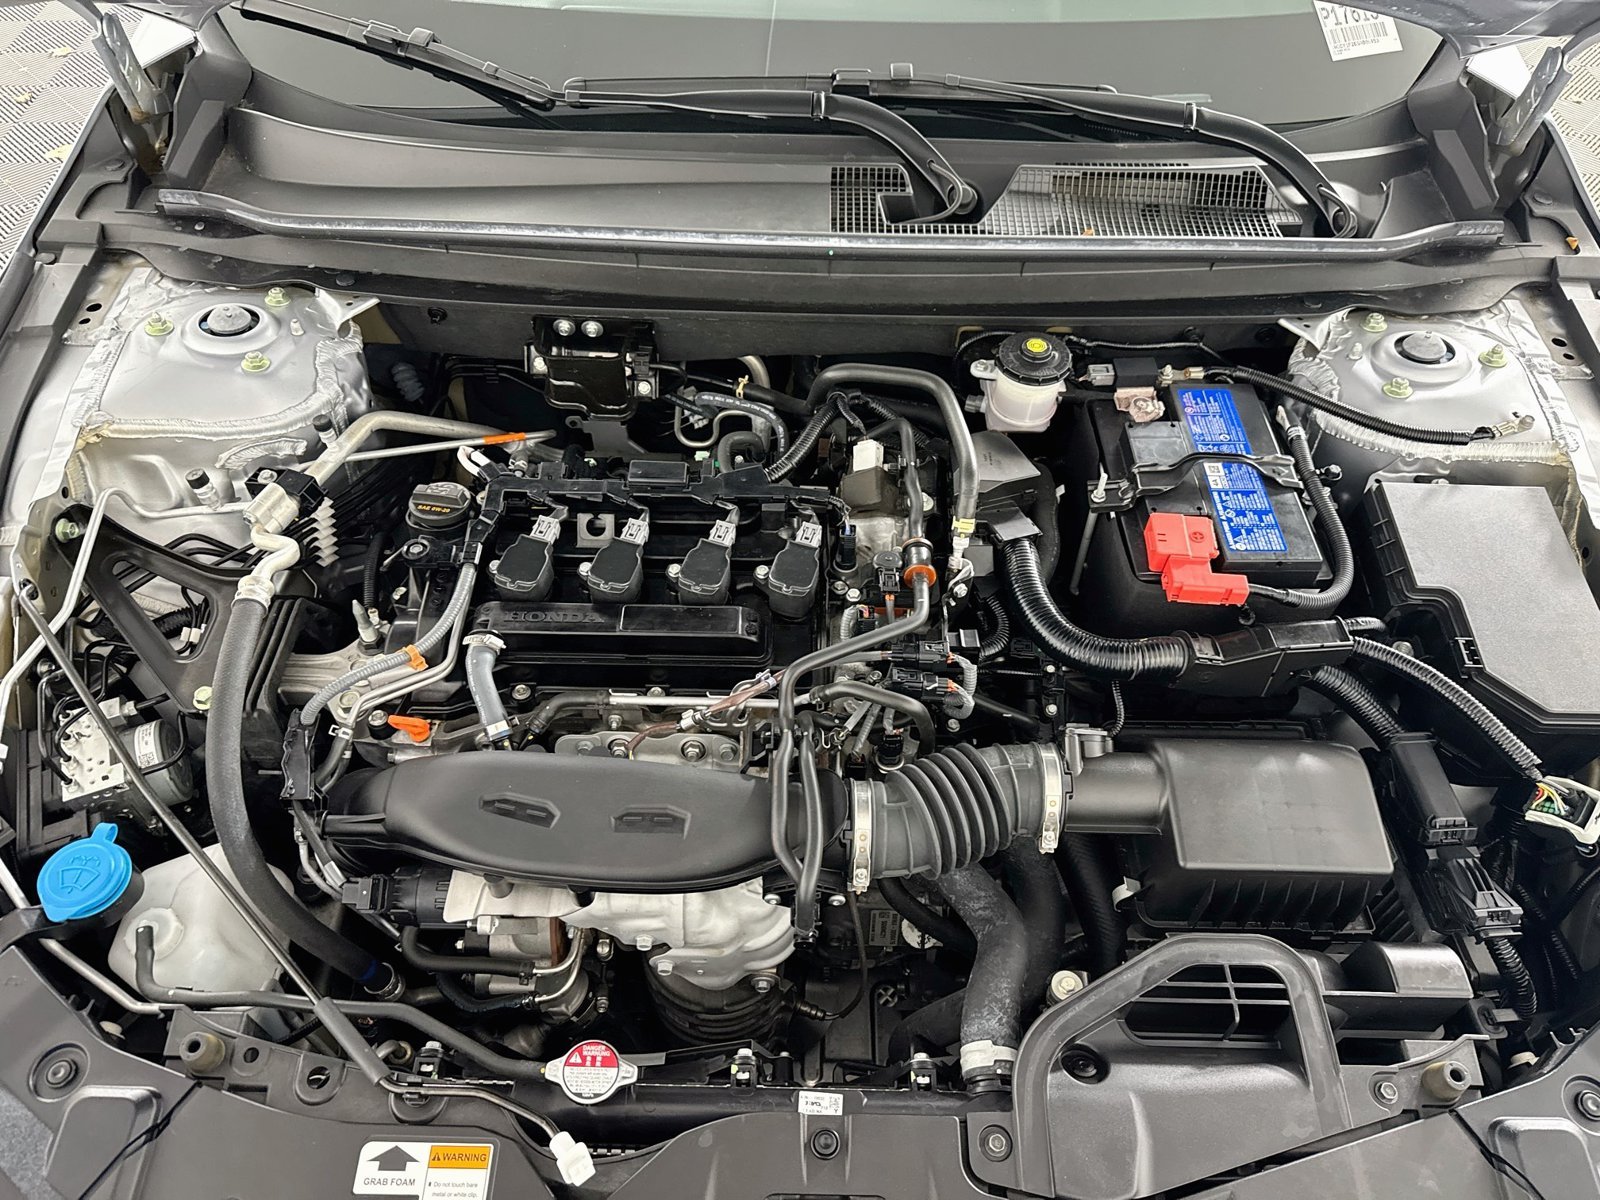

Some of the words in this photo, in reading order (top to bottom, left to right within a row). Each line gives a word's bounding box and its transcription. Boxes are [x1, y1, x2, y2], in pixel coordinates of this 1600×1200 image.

[503, 611, 605, 623] HONDA
[443, 1152, 487, 1162] WARNING
[363, 1177, 389, 1186] GRAB
[390, 1177, 416, 1186] FOAM
